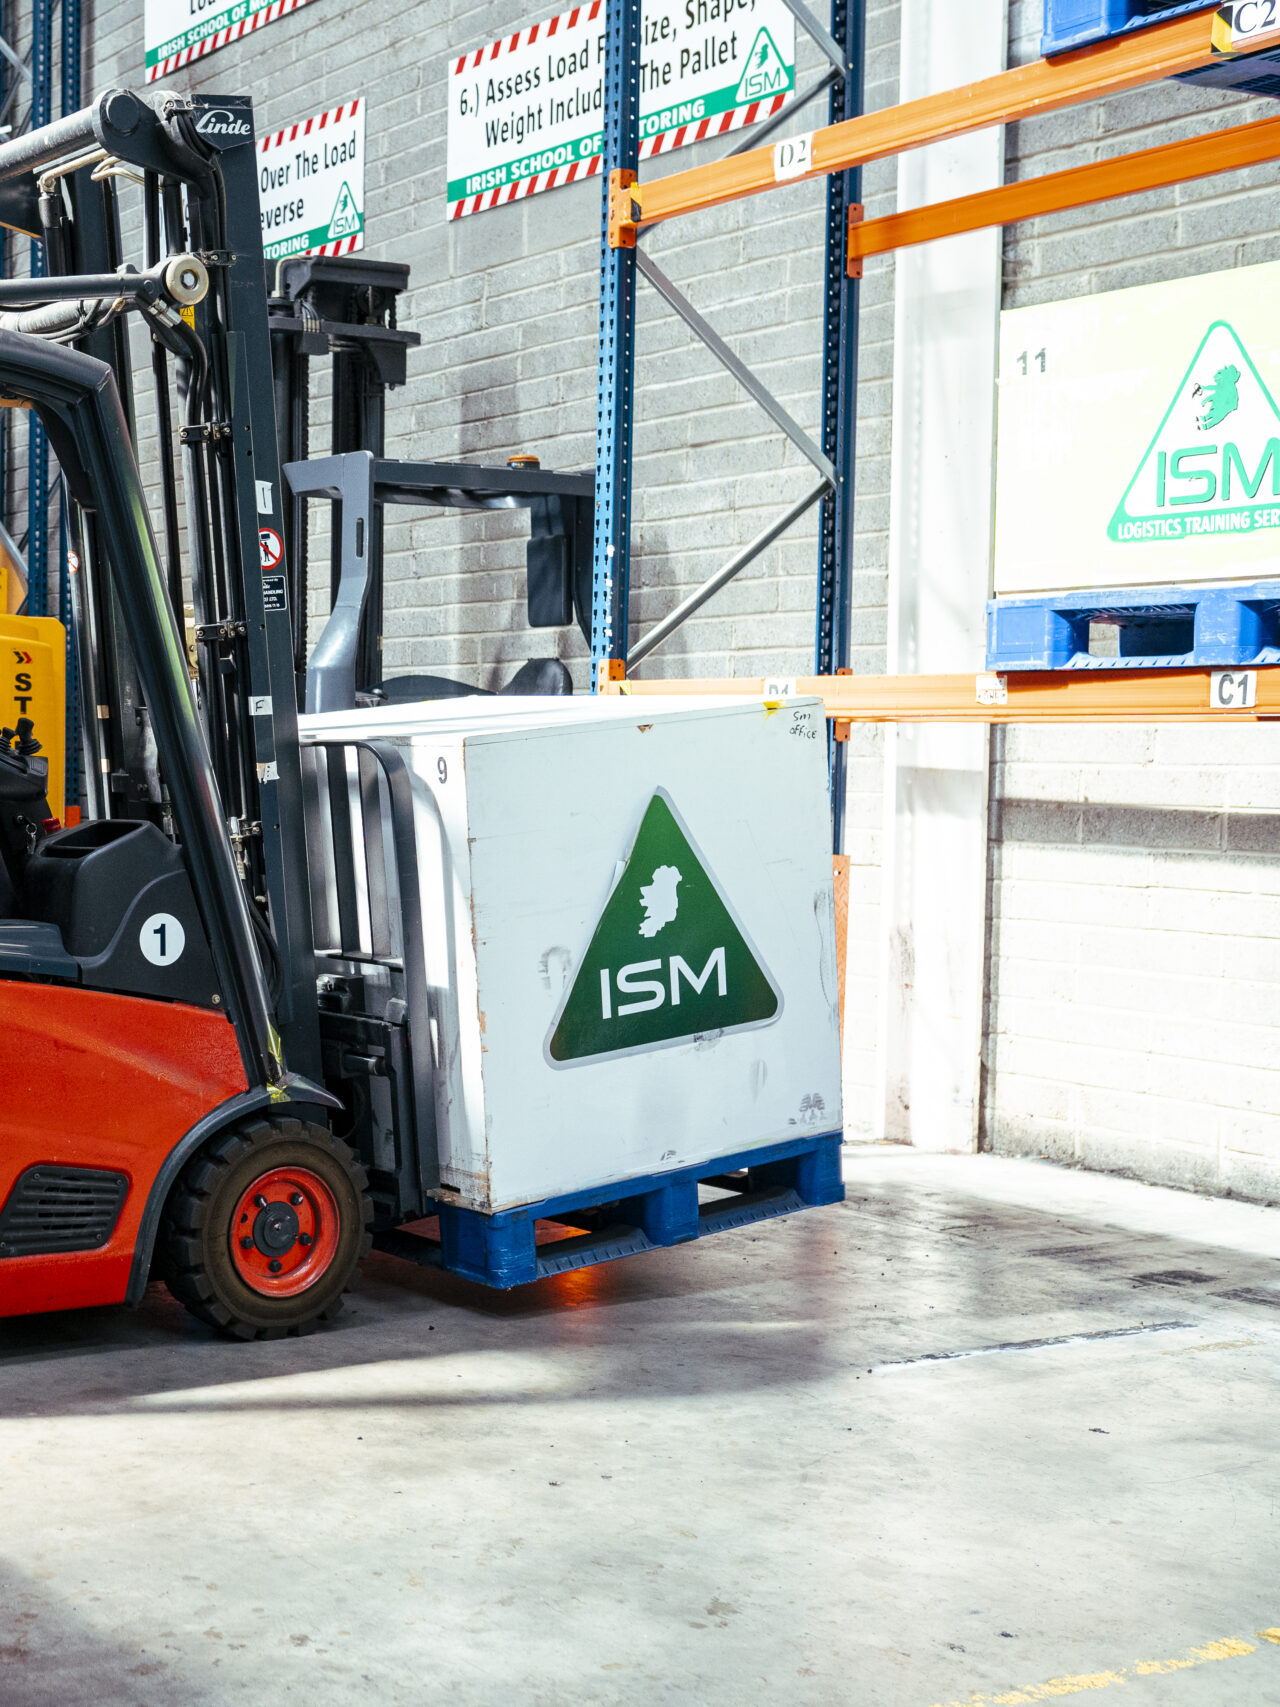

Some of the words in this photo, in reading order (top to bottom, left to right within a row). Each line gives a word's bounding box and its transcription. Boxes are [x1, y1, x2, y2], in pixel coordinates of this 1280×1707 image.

[157, 36, 186, 61] IRISH
[187, 13, 231, 45] SCHOOL
[231, 5, 248, 23] OF
[1234, 0, 1277, 34] C2
[460, 83, 480, 118] 6.)
[485, 66, 541, 107] Assess
[548, 38, 589, 83] Load
[640, 15, 677, 46] ize,
[744, 67, 781, 98] ISM
[485, 103, 543, 148] Weight
[550, 79, 603, 126] Includ
[640, 60, 672, 93] The
[680, 31, 738, 79] Pallet
[195, 109, 251, 135] Linde
[260, 163, 291, 194] Over
[295, 150, 319, 181] The
[324, 129, 356, 170] Load
[465, 169, 507, 194] IRISH
[510, 145, 575, 179] SCHOOL
[579, 134, 603, 158] OF
[640, 99, 706, 137] TORING
[780, 139, 807, 168] D2
[260, 198, 305, 231] verse
[333, 214, 356, 236] ISM
[264, 234, 310, 260] TORING
[1016, 347, 1047, 376] 11
[1156, 437, 1280, 508] ISM
[1117, 518, 1182, 540] LOGISTICS
[1184, 508, 1251, 534] TRAINING
[1218, 673, 1249, 706] C1
[437, 756, 448, 784] 9
[153, 923, 166, 957] 1
[600, 946, 727, 1020] ISM
